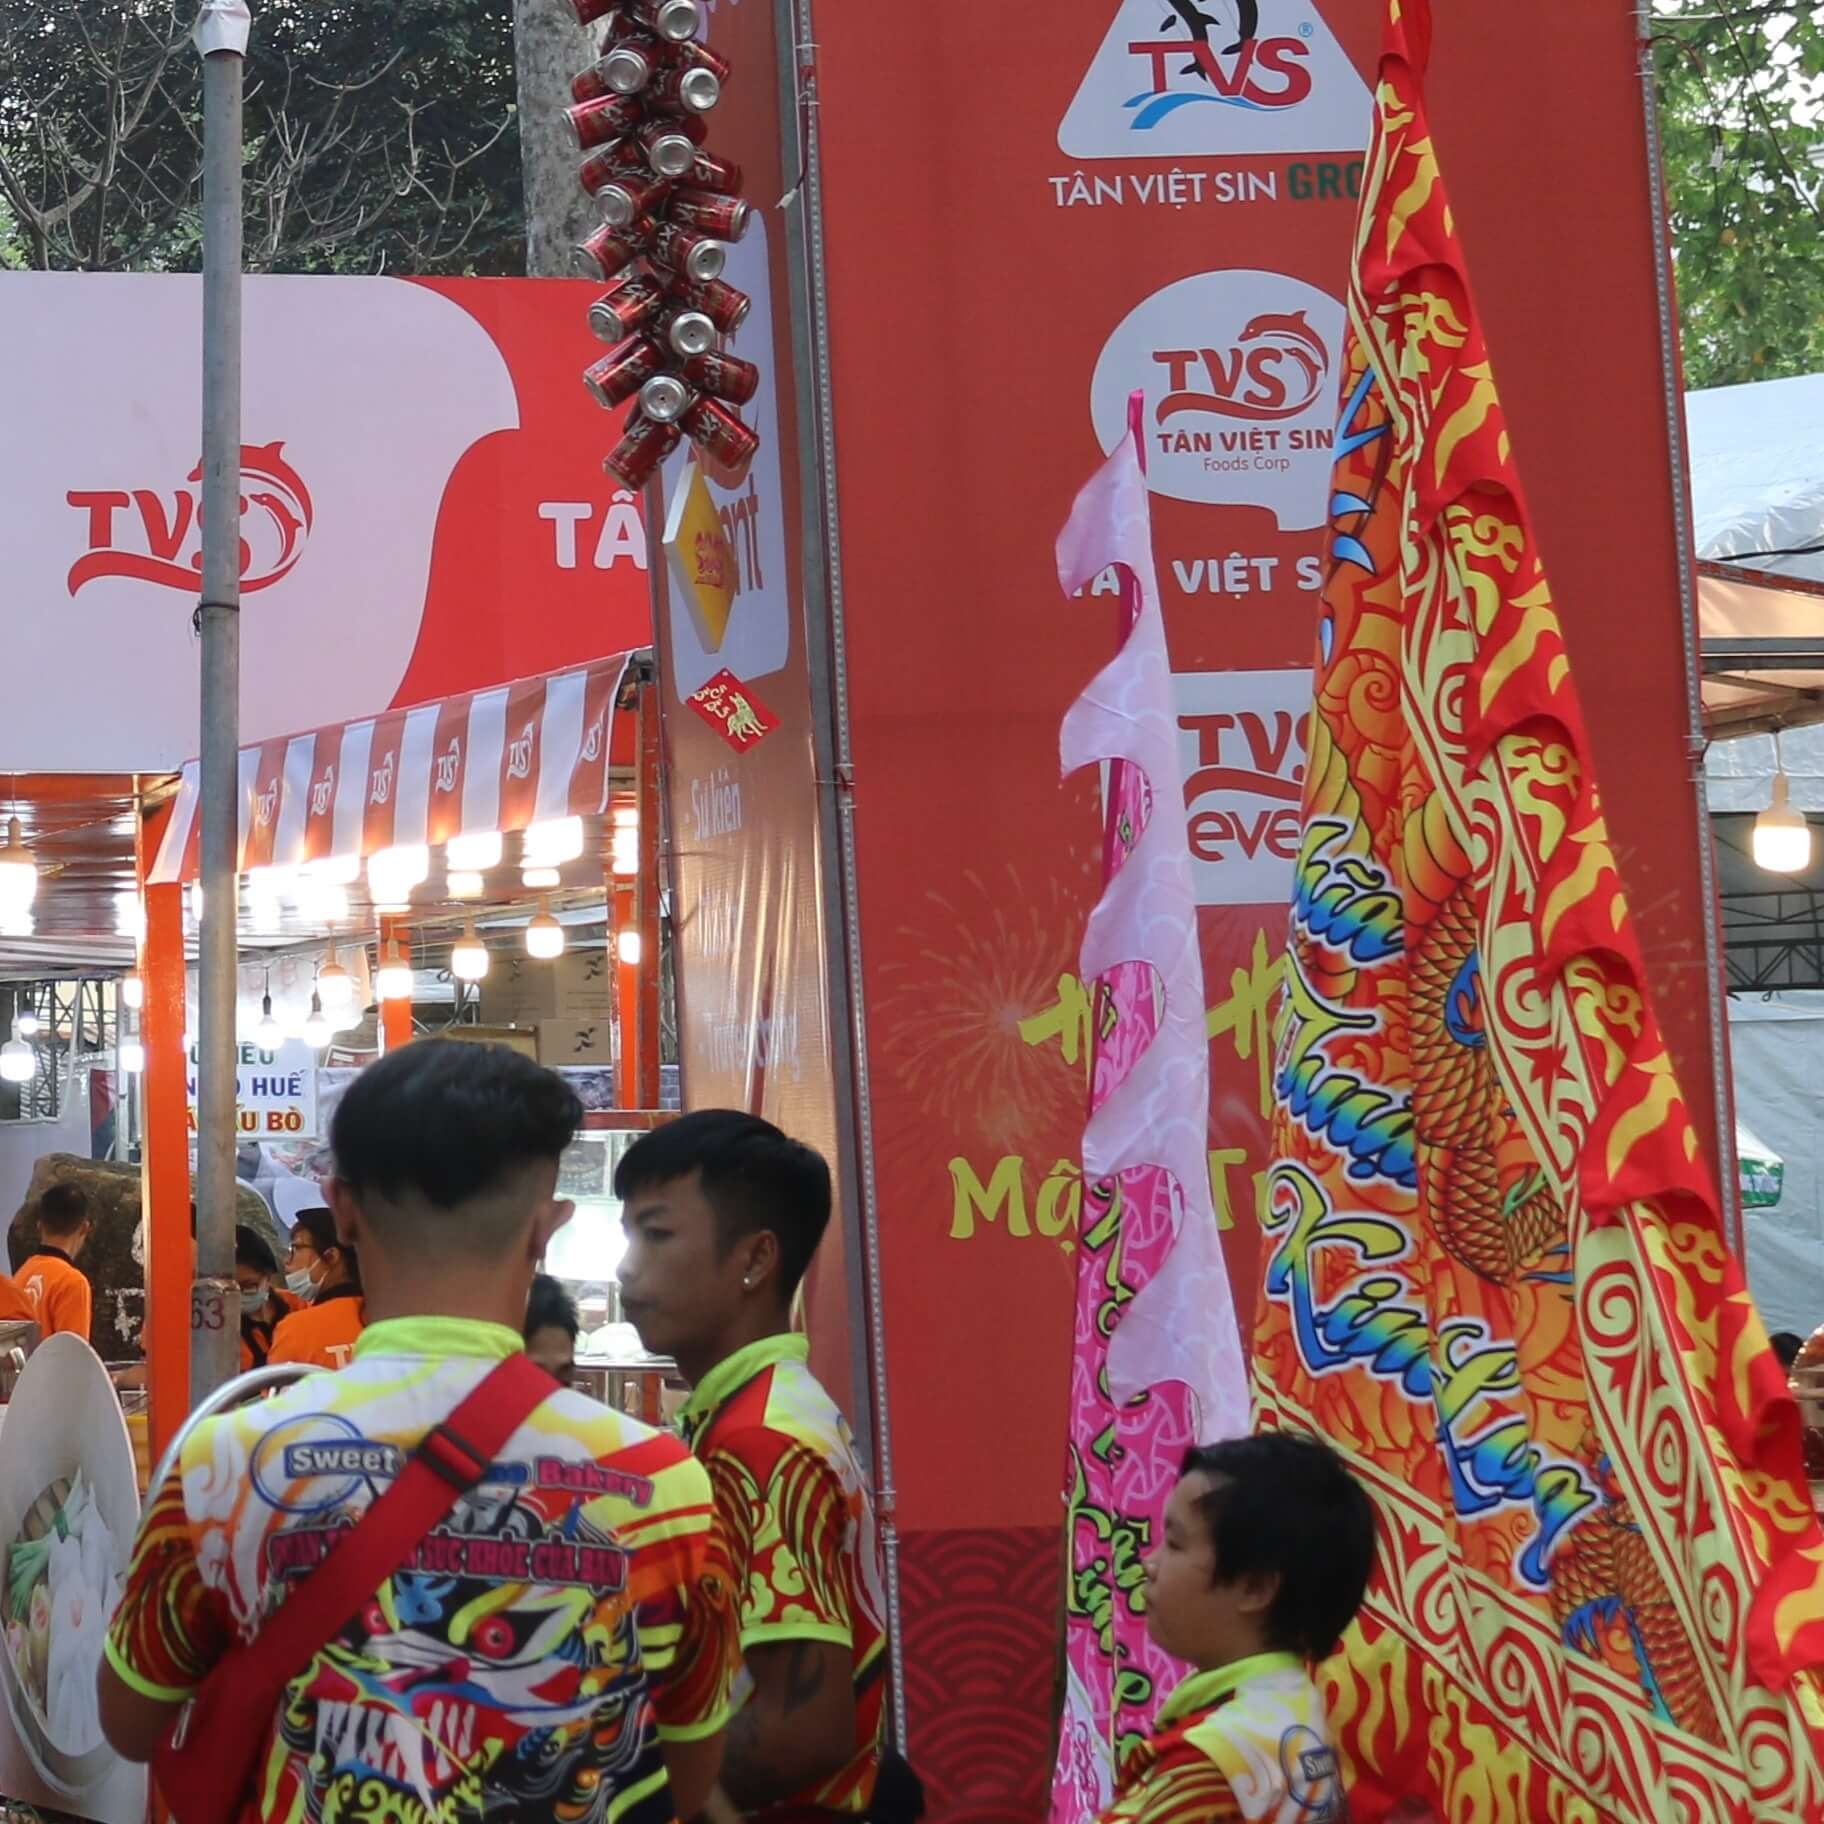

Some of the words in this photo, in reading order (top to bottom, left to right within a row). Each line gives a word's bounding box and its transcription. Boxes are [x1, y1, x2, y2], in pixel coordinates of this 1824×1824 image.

[1128, 37, 1312, 107] TVS
[1049, 170, 1123, 206] TÂN
[1129, 168, 1208, 210] VIỆT
[1215, 172, 1277, 203] SIN
[1287, 161, 1365, 201] GRO
[1152, 347, 1287, 407] TVS
[1157, 429, 1213, 452] TÂN
[1219, 427, 1281, 456] VIỆT
[1288, 428, 1334, 450] SIN
[1203, 456, 1249, 471] Foods
[1253, 455, 1290, 473] Corp
[538, 489, 648, 570] TÂ
[1172, 551, 1280, 600] VIỆT
[1189, 810, 1302, 863] eve
[252, 1069, 305, 1097] HUẾ
[266, 1105, 303, 1132] BÒ
[949, 1152, 1081, 1257] Mậ
[292, 1448, 398, 1473] Sweet
